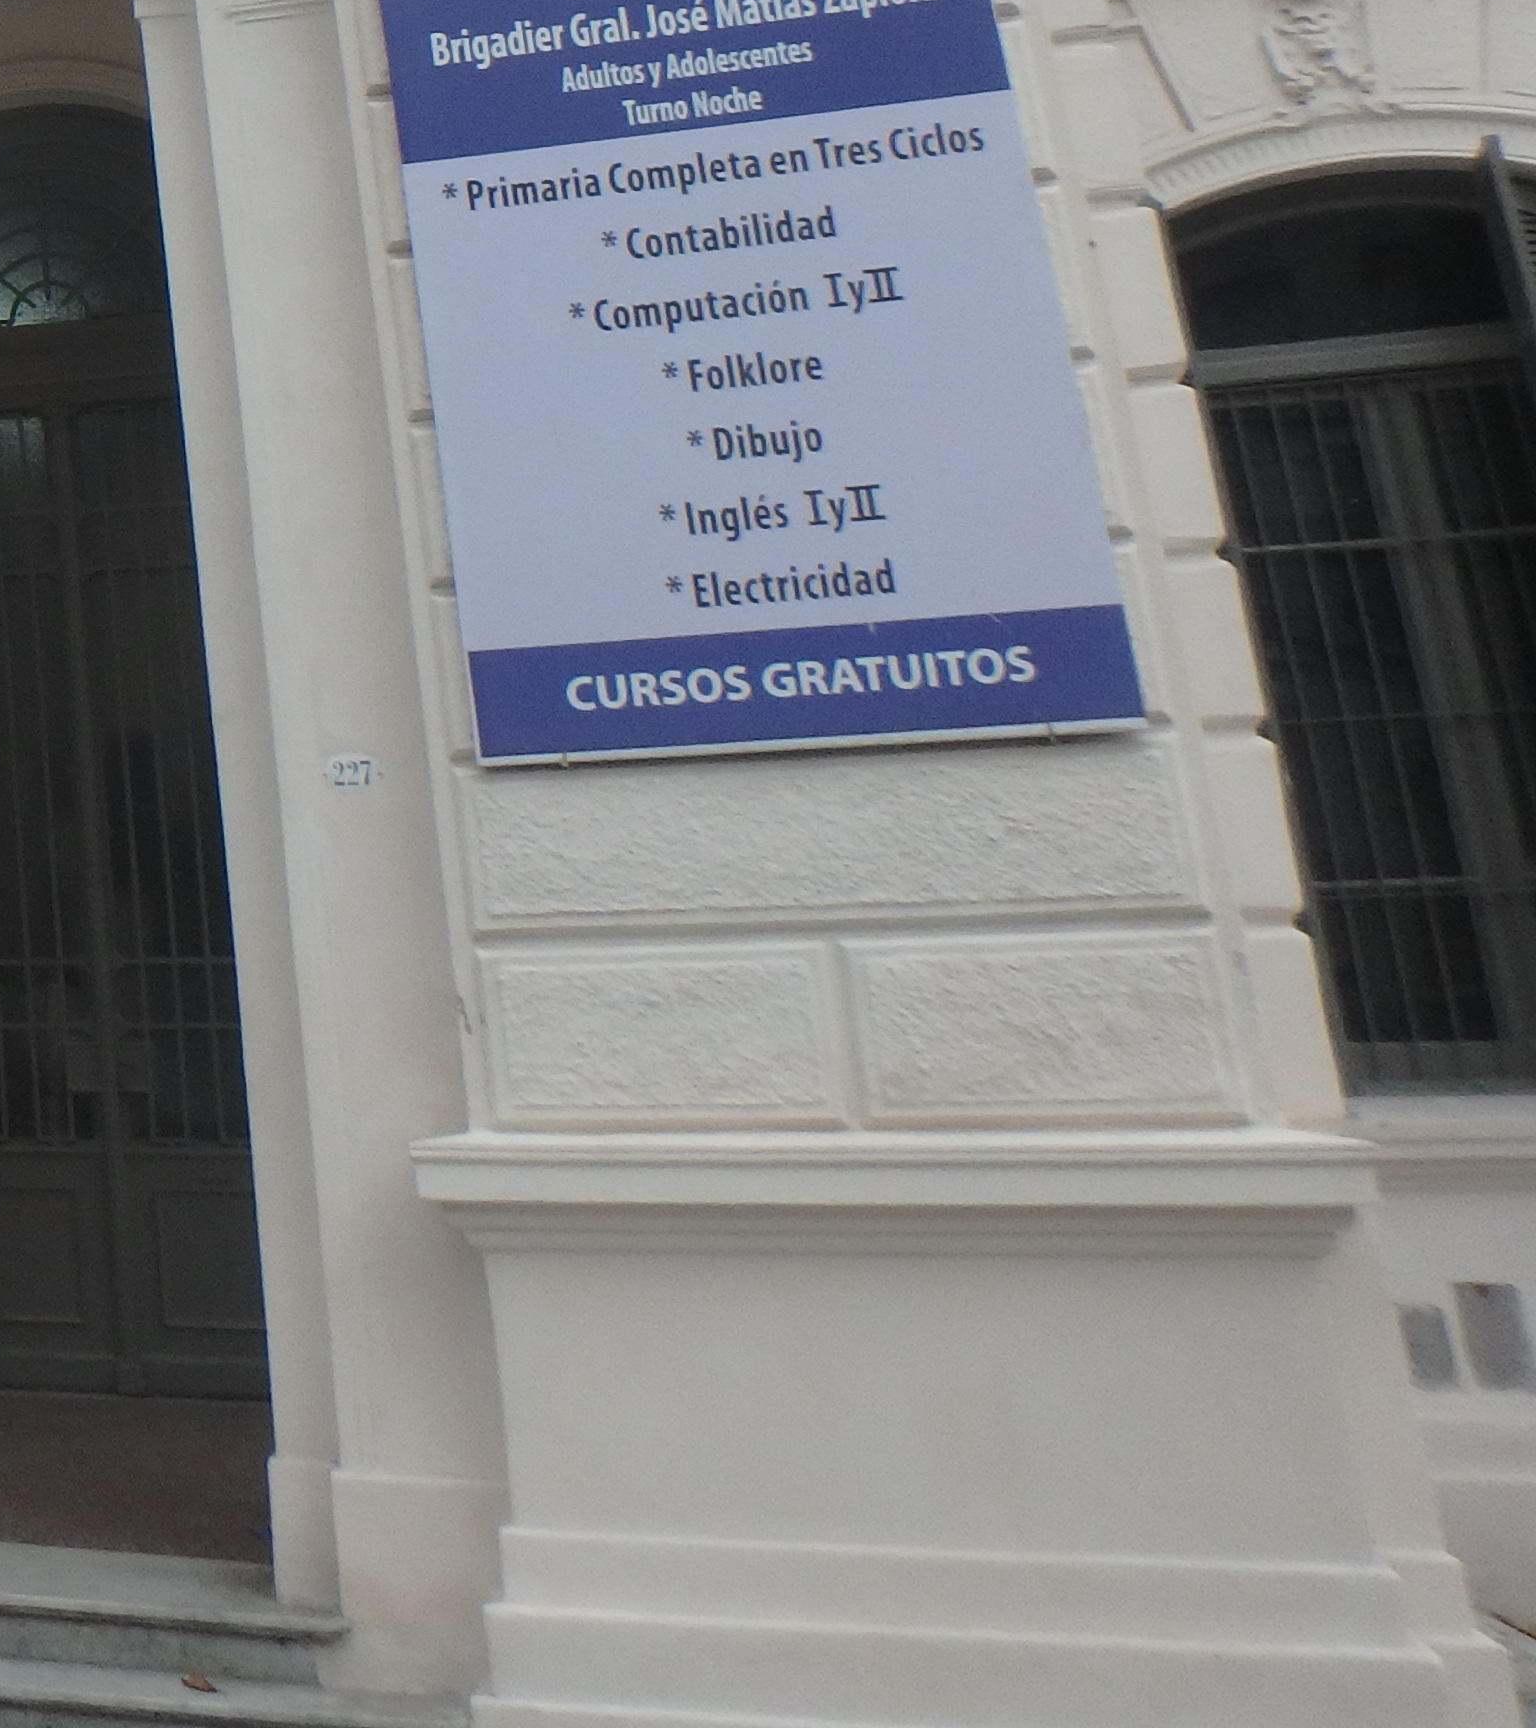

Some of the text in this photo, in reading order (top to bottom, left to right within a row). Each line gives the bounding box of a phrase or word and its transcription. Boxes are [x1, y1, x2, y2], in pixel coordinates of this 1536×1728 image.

[430, 20, 565, 70] Brigadier
[569, 6, 641, 47] Gral.
[562, 41, 813, 94] Adultos y Adolescentes
[622, 85, 764, 126] Turno Noche
[466, 122, 985, 211] Primaria Completa en Tres Ciclos
[626, 205, 837, 260] Contabilidad
[594, 279, 810, 334] Computación
[687, 351, 823, 393] Folklore
[712, 420, 823, 464] Dibujo
[685, 494, 790, 542] Inglés
[691, 557, 897, 609] Electricidad
[566, 645, 1036, 711] CURSOS GRATUITOS
[332, 760, 371, 786] 227
